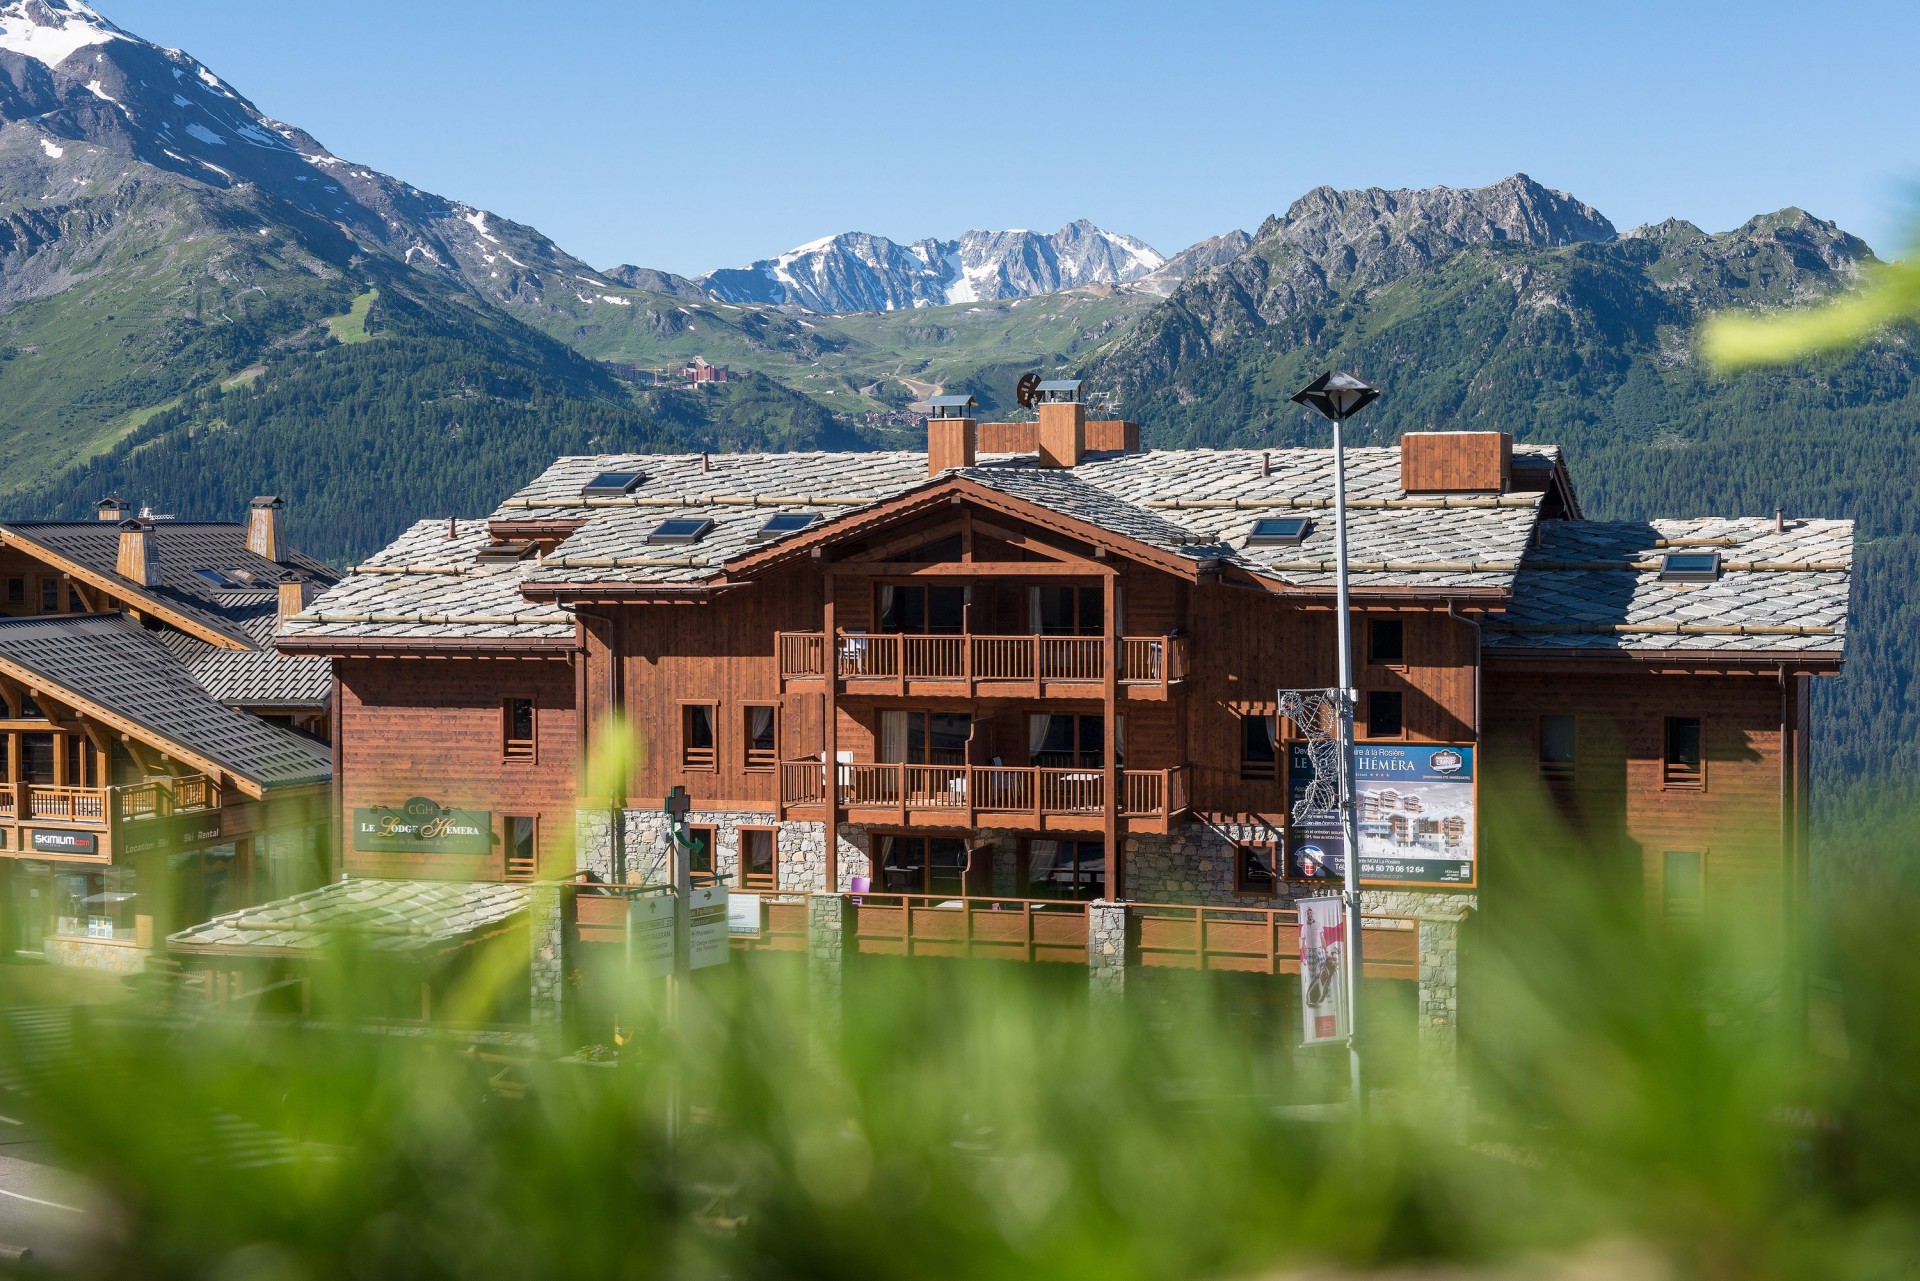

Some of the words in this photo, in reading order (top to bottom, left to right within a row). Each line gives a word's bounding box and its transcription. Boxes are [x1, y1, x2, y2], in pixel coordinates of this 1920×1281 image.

[1379, 749, 1405, 757] Rosière
[1294, 758, 1307, 769] LE
[1359, 757, 1416, 771] HÉMÉRA
[408, 803, 434, 815] CGH
[361, 822, 376, 833] LE
[378, 815, 419, 837] LODGE
[420, 817, 480, 838] HEMERA
[184, 833, 195, 843] Ski
[197, 828, 219, 840] Rental
[125, 841, 155, 854] Location
[1361, 864, 1374, 873] (0)4
